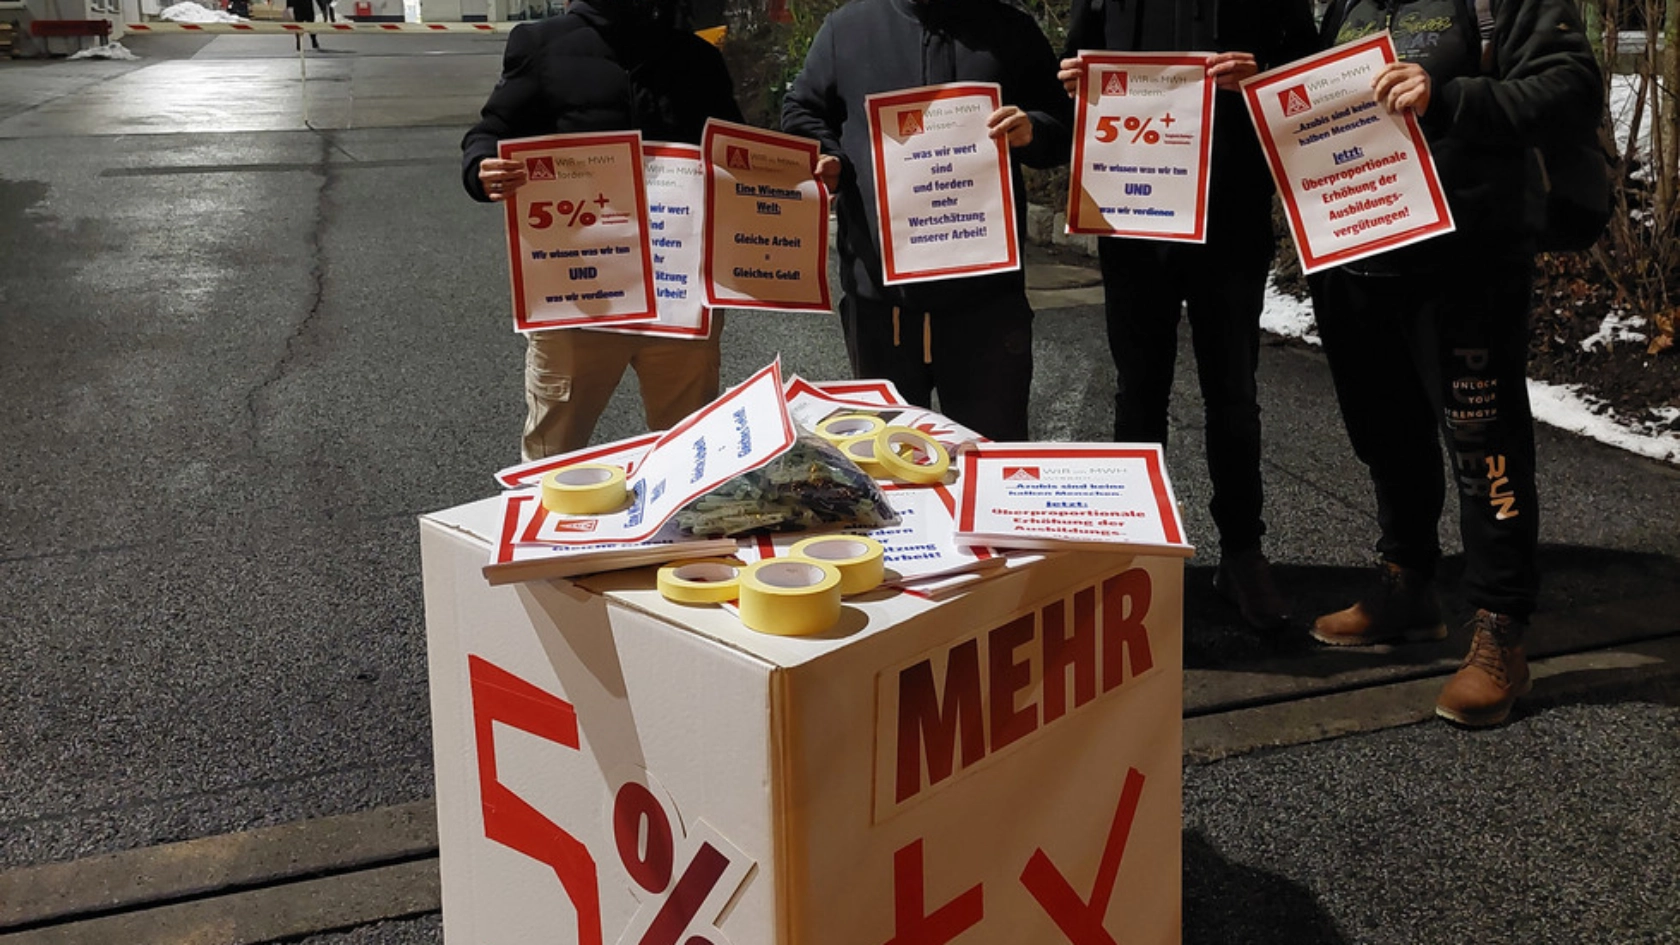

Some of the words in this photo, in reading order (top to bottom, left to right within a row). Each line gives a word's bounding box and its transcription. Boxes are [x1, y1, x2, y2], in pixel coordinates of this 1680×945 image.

[1129, 75, 1148, 83] WIR
[1161, 75, 1187, 84] MWH
[1308, 79, 1328, 92] WIR
[1341, 64, 1370, 79] MWH
[925, 108, 942, 118] WIR
[955, 103, 980, 114] MWH
[1331, 107, 1351, 120] sind
[1351, 100, 1377, 113] keine
[1299, 131, 1330, 146] halben
[934, 145, 951, 157] wir
[952, 143, 977, 155] wert
[1333, 146, 1364, 165] Jetzt:
[931, 162, 953, 175] sind
[1093, 163, 1107, 172] Wir
[1109, 163, 1138, 174] wissen
[1139, 166, 1156, 175] was
[1158, 166, 1171, 175] wir
[1173, 167, 1187, 176] tun
[1302, 151, 1407, 191] Überproportionale
[736, 183, 756, 195] Eine
[758, 185, 802, 200] Wiemann
[913, 180, 933, 193] und
[935, 178, 974, 191] fordern
[1124, 183, 1152, 196] UND
[1322, 180, 1377, 204] Erhöhung
[1378, 173, 1398, 186] der
[650, 203, 665, 213] wir
[667, 204, 690, 215] wert
[757, 201, 781, 215] Welt:
[931, 196, 958, 208] mehr
[1329, 193, 1403, 221] Ausbildungs-
[1099, 206, 1115, 214] was
[1117, 205, 1131, 215] wir
[1133, 206, 1174, 217] verdienen
[651, 221, 665, 230] nd
[908, 211, 985, 228] Wertschätzung
[1333, 206, 1409, 238] vergütungen!
[734, 233, 770, 245] Gleiche
[772, 236, 801, 248] Arbeit
[910, 231, 949, 245] unserer
[952, 226, 987, 240] Arbeit!
[651, 238, 682, 248] rdern
[531, 249, 547, 259] Wir
[549, 249, 579, 259] wissen
[581, 248, 598, 256] was
[600, 245, 613, 255] wir
[615, 246, 630, 254] tun
[654, 254, 665, 263] hr
[569, 266, 597, 280] UND
[733, 267, 773, 279] Gleiches
[775, 268, 801, 281] Geld!
[565, 292, 578, 302] wir
[581, 289, 625, 300] verdienen
[1452, 379, 1497, 390] UNLOCK
[1485, 454, 1520, 520] RUN
[1046, 501, 1088, 509] Jetzt:
[991, 508, 1145, 518] Überproportionale
[1013, 518, 1094, 528] Erhöhung
[1097, 519, 1125, 527] der
[896, 568, 1154, 804] MEHR
